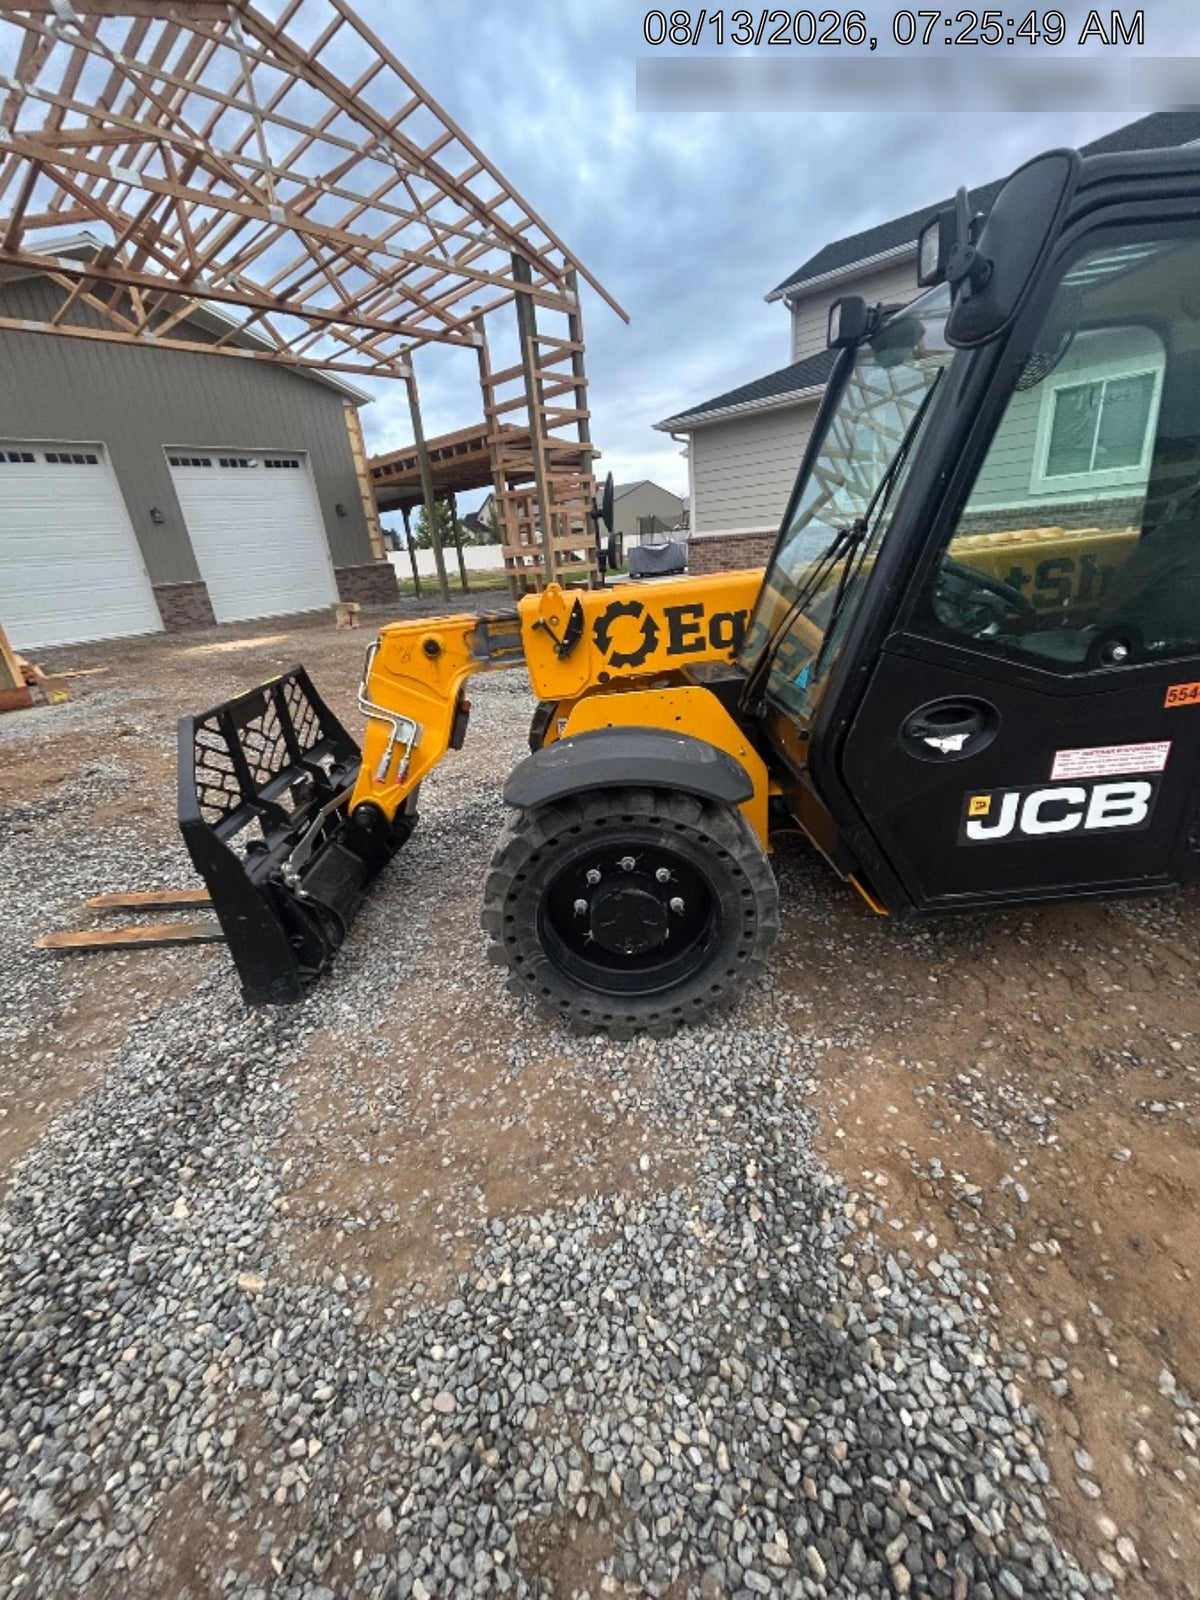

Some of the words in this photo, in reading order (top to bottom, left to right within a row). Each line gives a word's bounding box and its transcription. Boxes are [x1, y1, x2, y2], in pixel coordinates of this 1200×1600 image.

[663, 603, 752, 659] Eq
[1167, 685, 1200, 703] 554
[966, 781, 1151, 840] JCB
